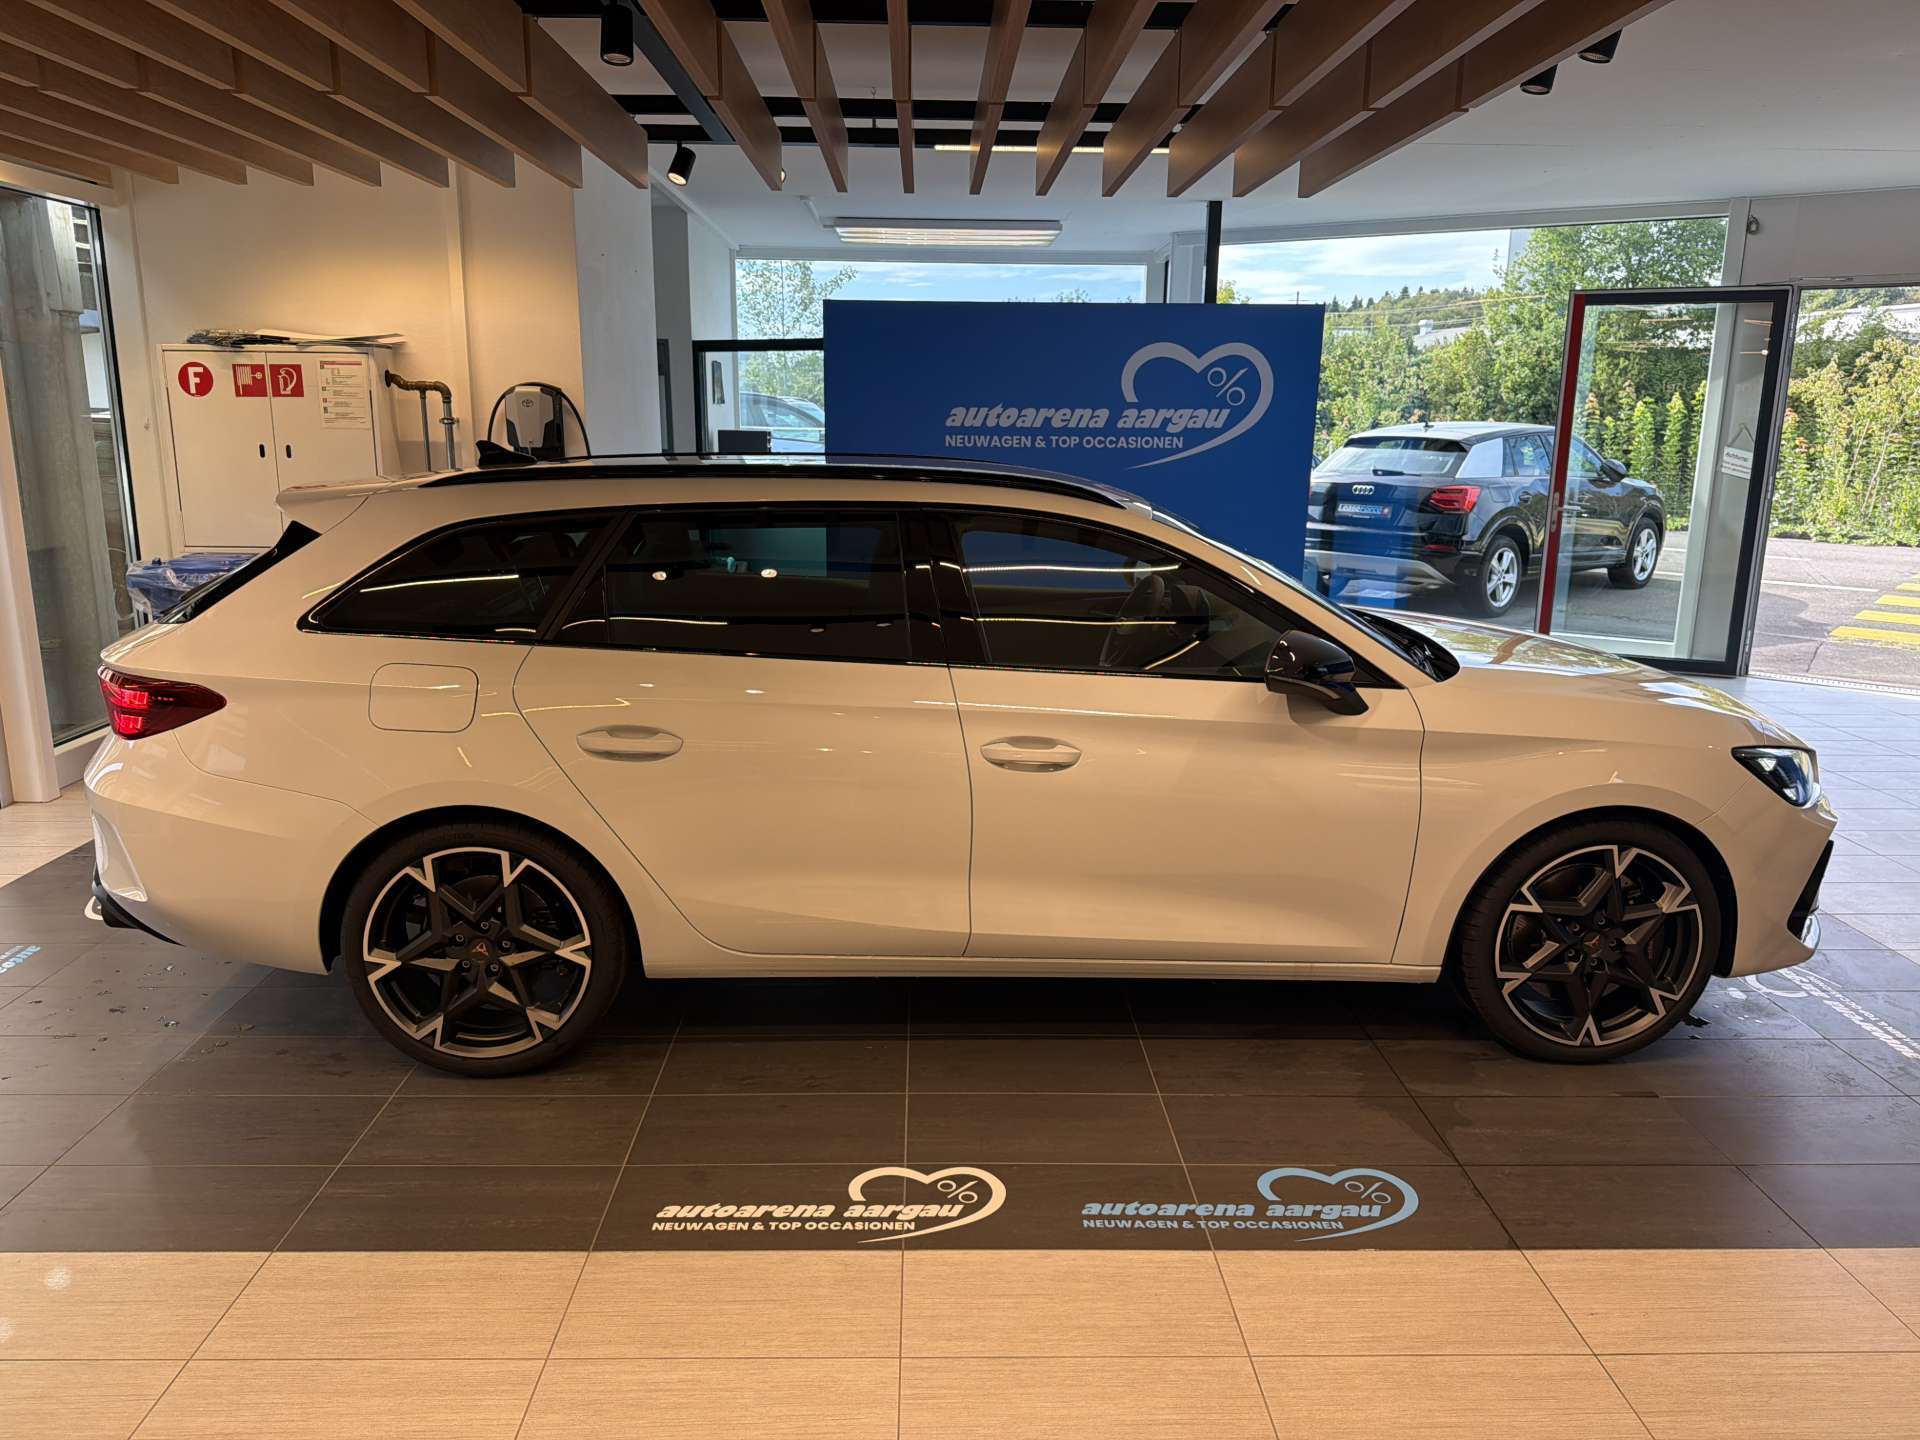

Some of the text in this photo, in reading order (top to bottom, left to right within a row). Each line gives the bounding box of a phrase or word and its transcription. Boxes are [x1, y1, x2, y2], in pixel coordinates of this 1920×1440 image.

[188, 366, 204, 394] F
[945, 403, 1231, 433] autoarena aargau
[945, 435, 1184, 449] NEUWAGEN & TOP OCCASIONEN
[656, 1203, 964, 1220] autoarena aargau
[1082, 1201, 1383, 1219] autoarena aargau
[652, 1222, 916, 1231] NEUWAGEN & TOP OCCASIONEN
[1083, 1220, 1345, 1230] NEUWAGEN & TOP OCCASIONEN
